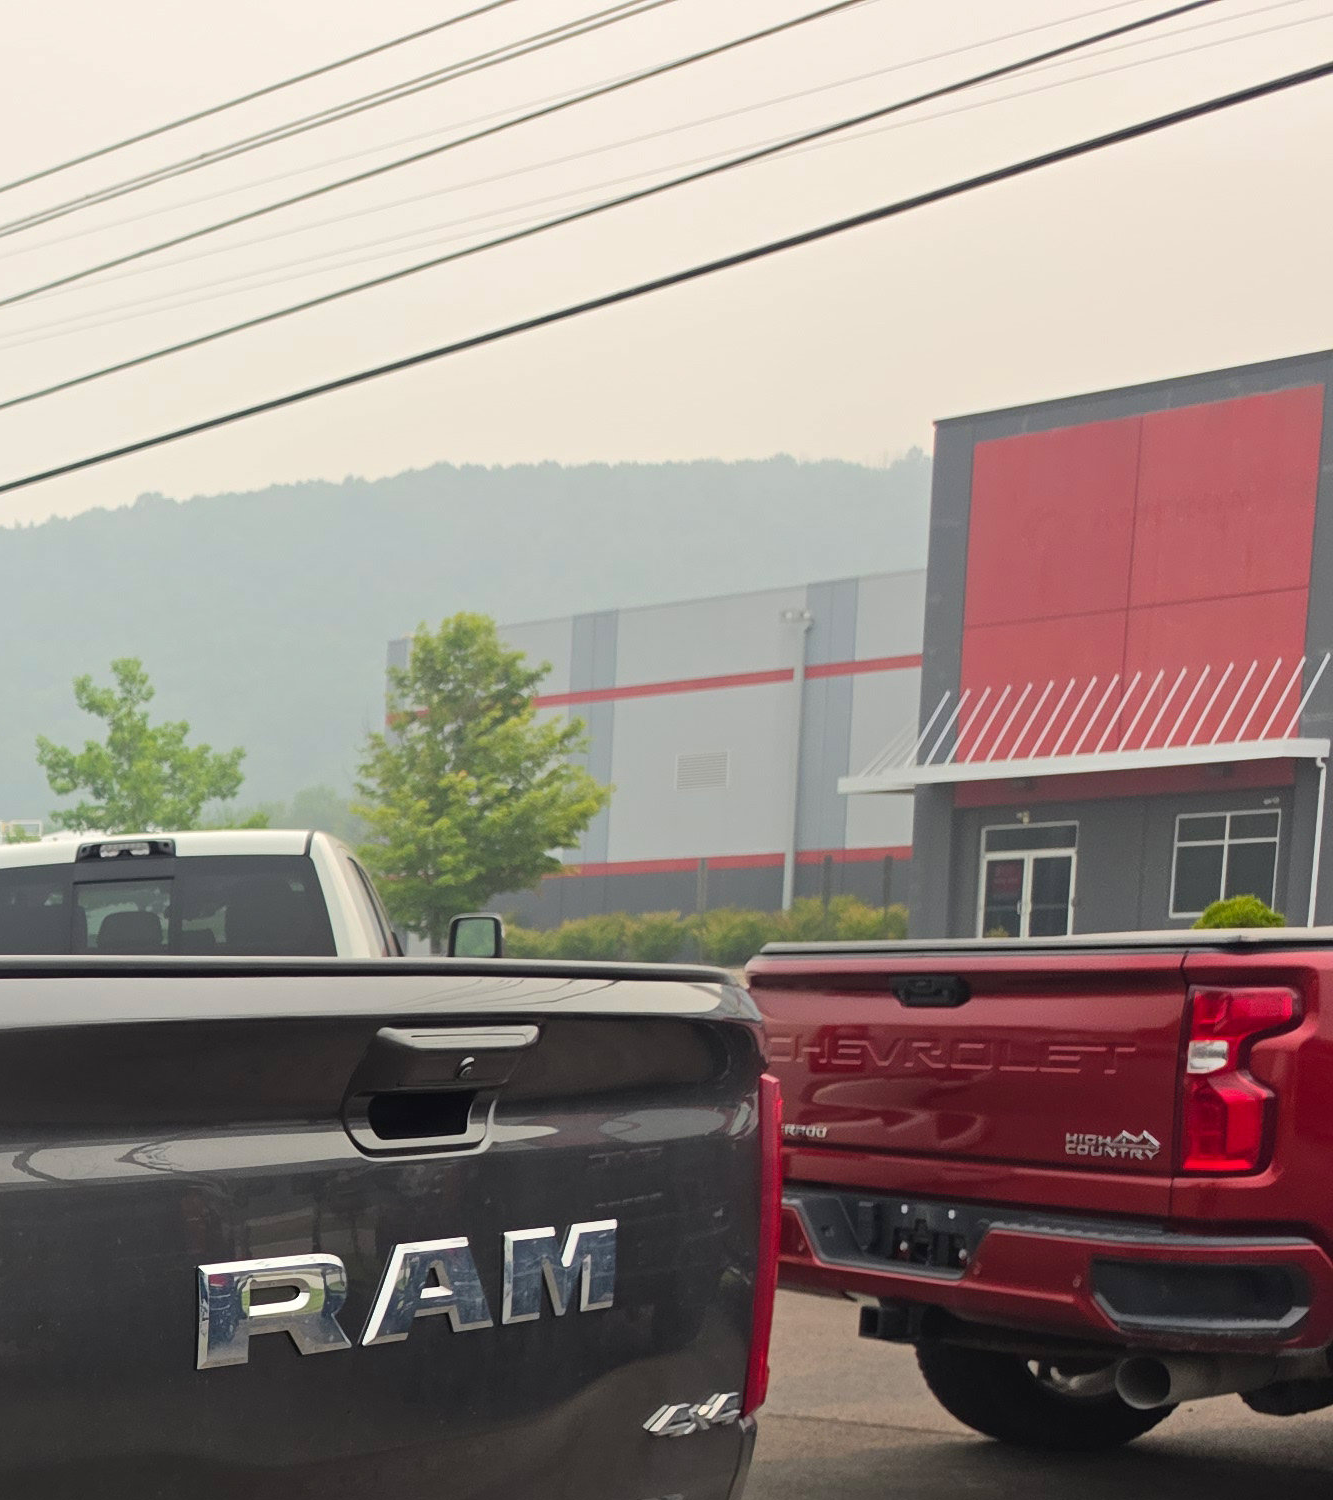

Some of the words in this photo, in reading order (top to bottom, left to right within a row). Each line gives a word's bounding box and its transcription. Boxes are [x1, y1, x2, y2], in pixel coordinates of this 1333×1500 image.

[765, 1035, 1136, 1075] CHEVROLET
[1065, 1132, 1113, 1146] HIGH
[1065, 1143, 1160, 1160] COUNTRY
[196, 1219, 618, 1370] RAM
